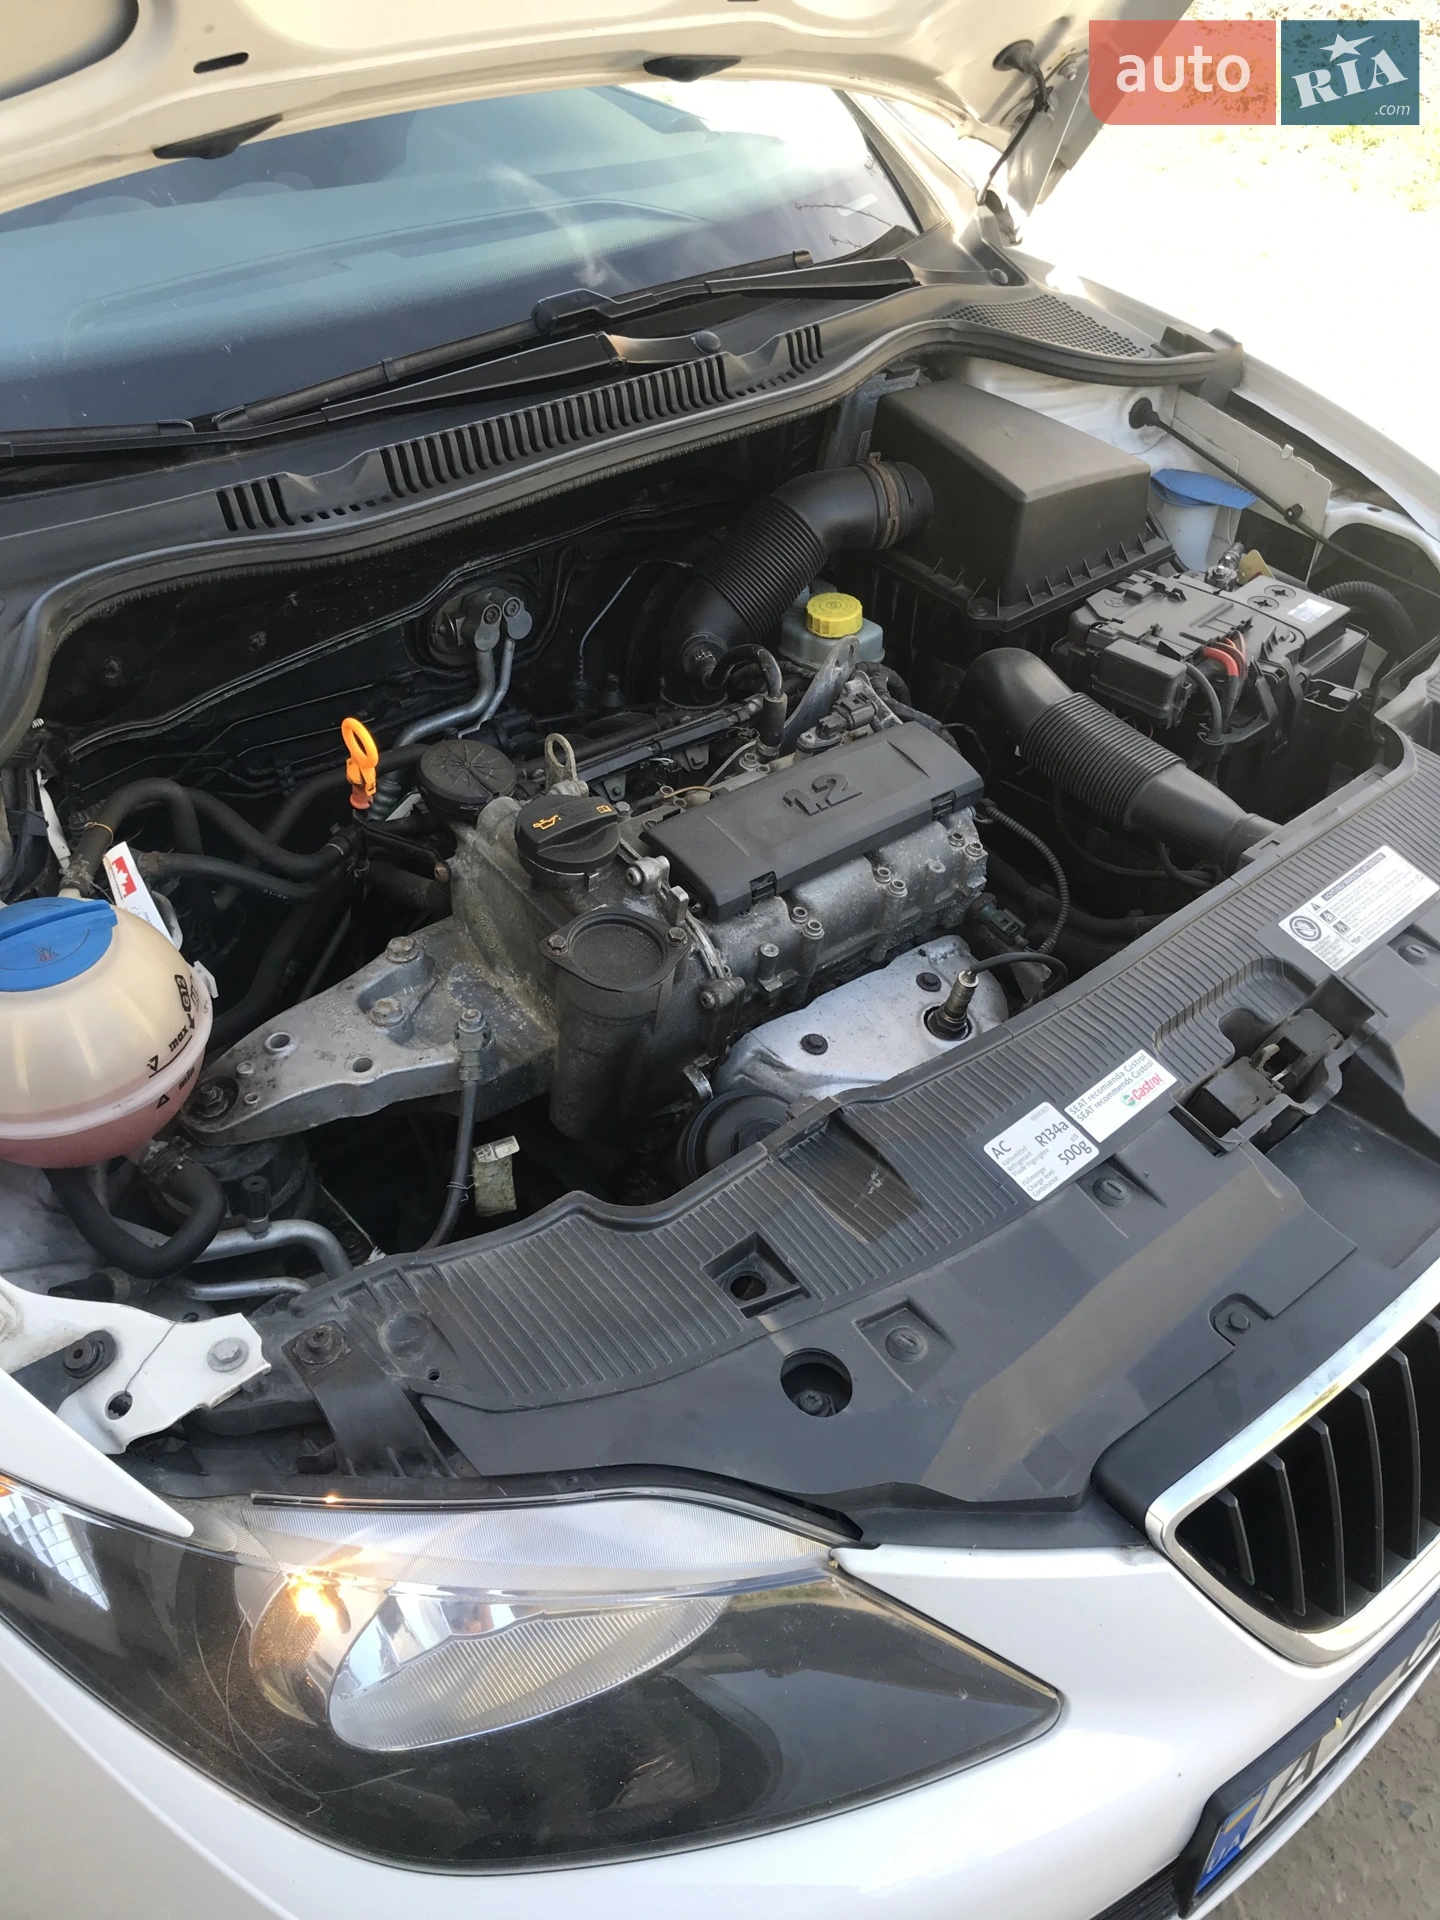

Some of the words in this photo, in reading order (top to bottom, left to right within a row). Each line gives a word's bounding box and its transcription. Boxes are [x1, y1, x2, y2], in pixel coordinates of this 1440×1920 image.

[782, 774, 863, 816] 1.2
[168, 1025, 188, 1052] max
[179, 1066, 195, 1090] min
[1068, 1098, 1087, 1115] SEAT
[1087, 1069, 1125, 1101] recomienda
[1123, 1053, 1147, 1072] Castrol
[1076, 1105, 1094, 1121] SEAT
[1093, 1077, 1133, 1108] recommends
[1130, 1059, 1154, 1078] Castrol
[1130, 1071, 1163, 1100] Castrol
[1034, 1121, 1069, 1147] R134a
[991, 1140, 1011, 1159] AC
[1057, 1140, 1092, 1165] 500g
[1026, 1177, 1044, 1191] Charge
[1042, 1168, 1055, 1179] level
[1031, 1175, 1059, 1196] Contenance
[1206, 1833, 1241, 1874] UA
